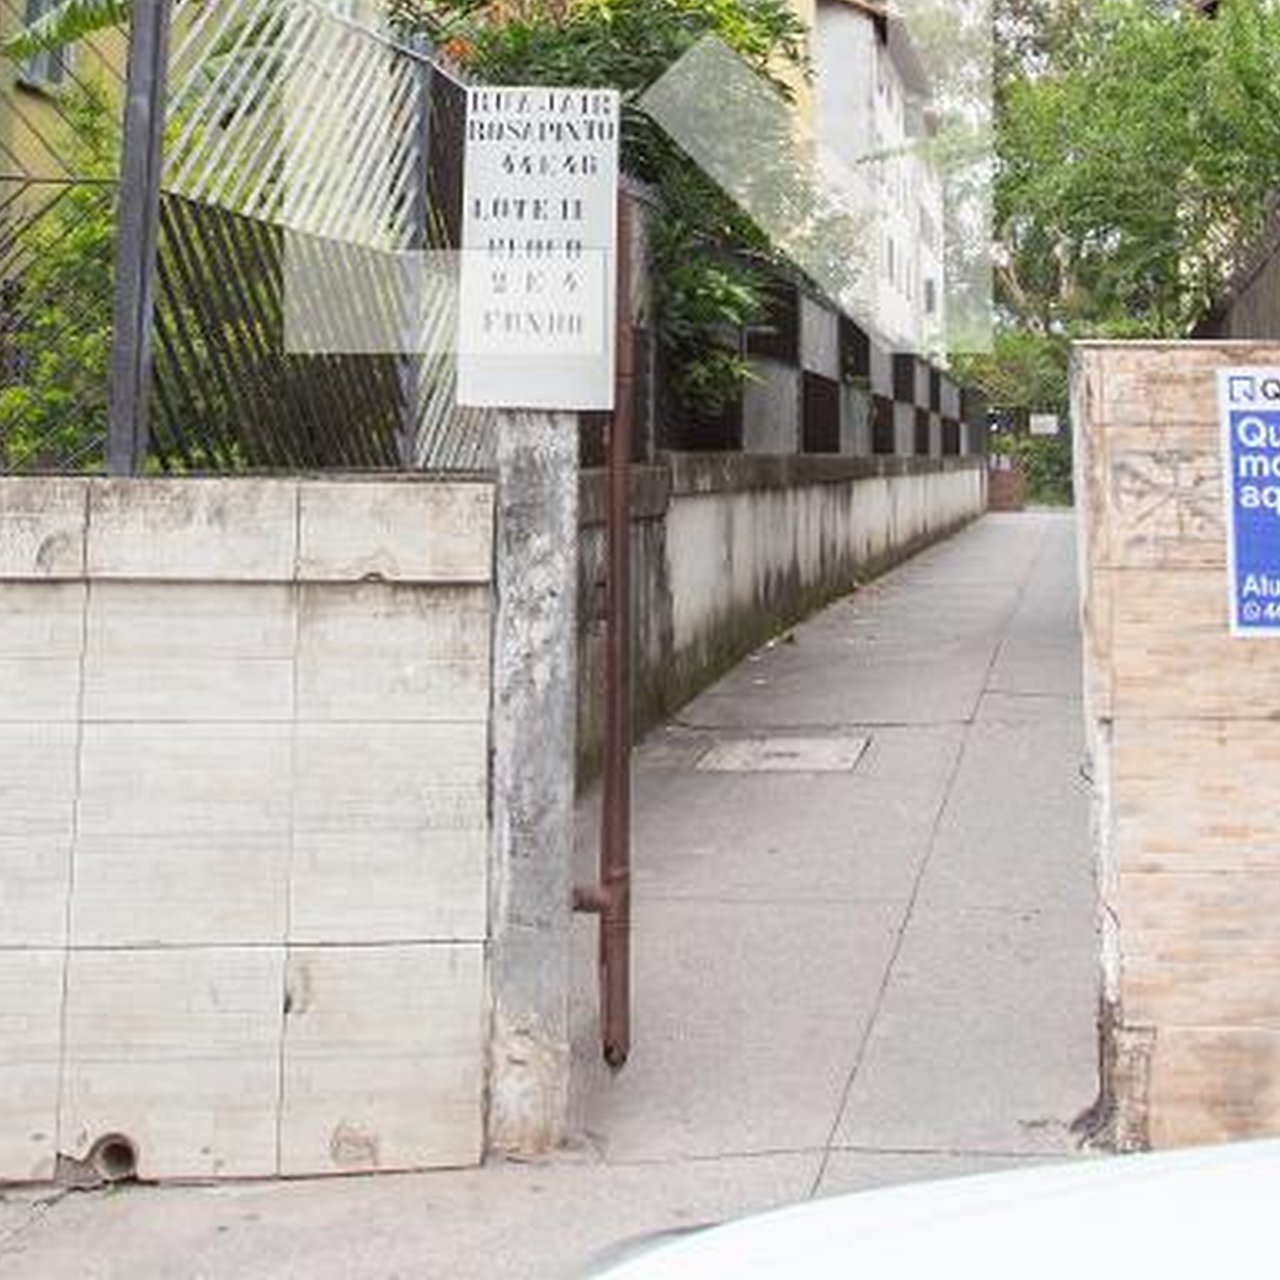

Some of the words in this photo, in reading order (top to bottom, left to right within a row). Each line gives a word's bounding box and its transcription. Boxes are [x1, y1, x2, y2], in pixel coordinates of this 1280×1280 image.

[472, 91, 533, 114] RUA
[538, 120, 615, 142] PINTO
[474, 197, 549, 222] LOTE
